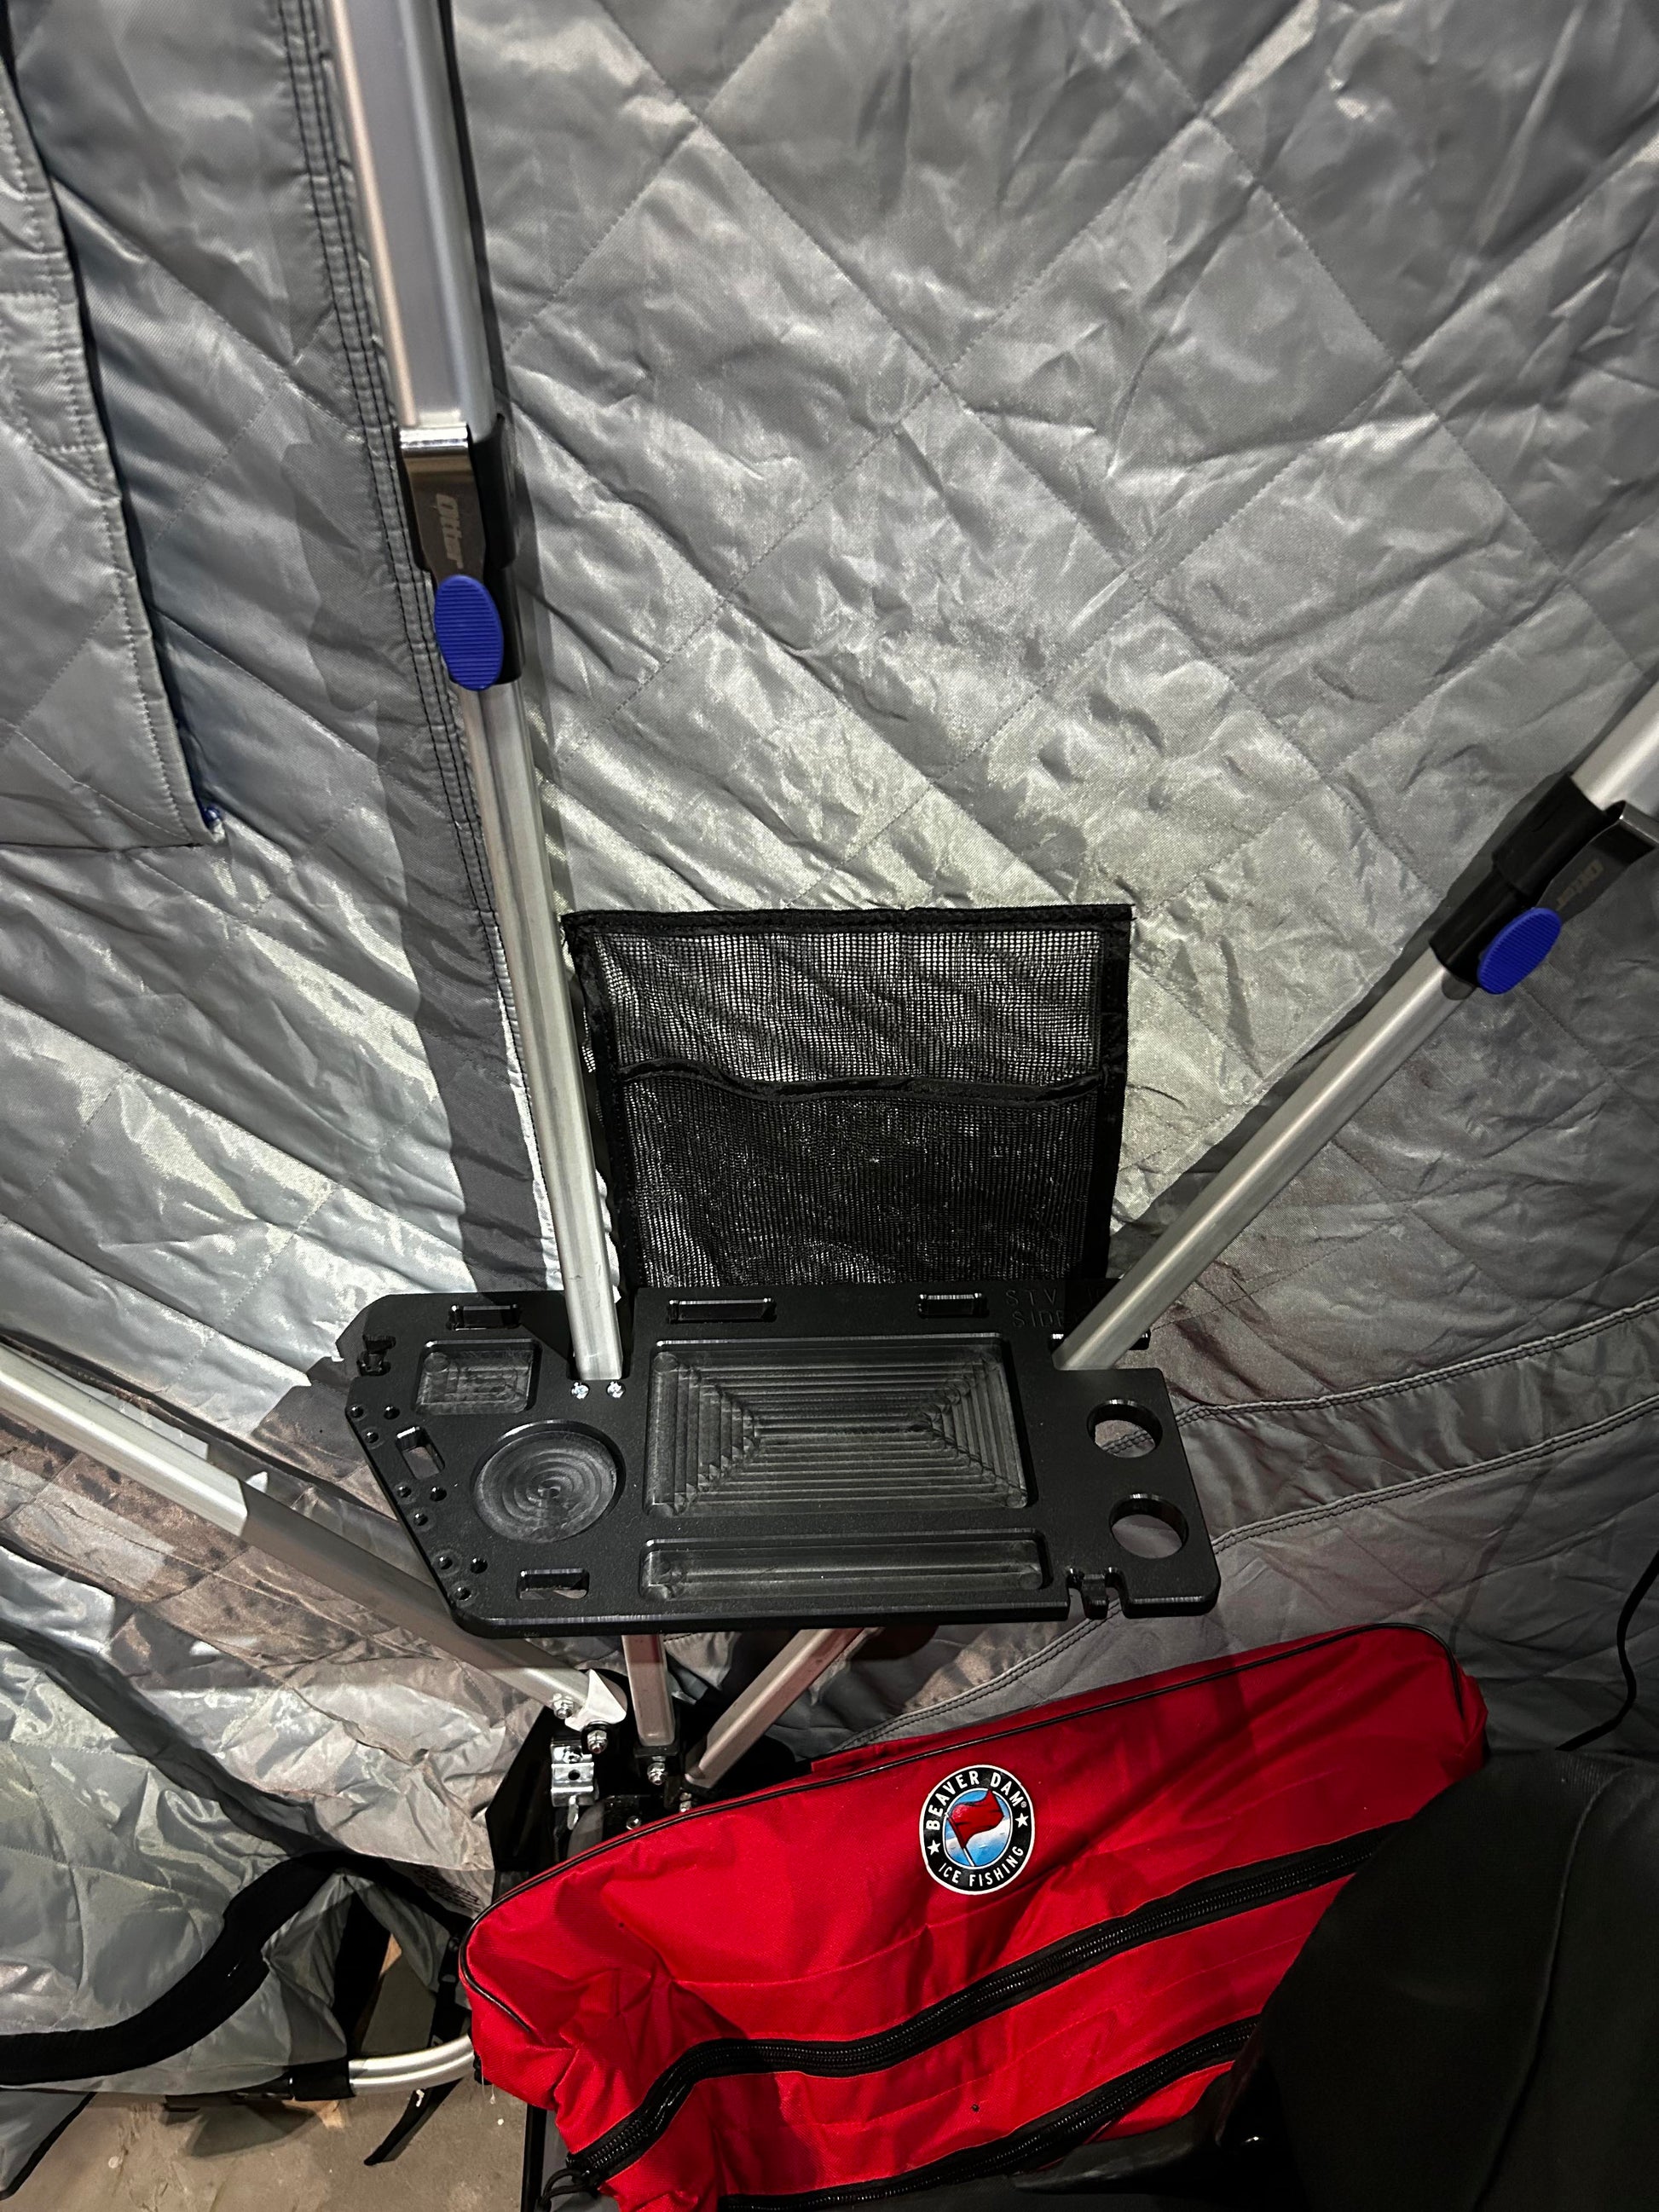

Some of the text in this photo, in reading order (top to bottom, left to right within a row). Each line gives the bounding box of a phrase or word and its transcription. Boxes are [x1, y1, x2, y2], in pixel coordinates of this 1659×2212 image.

[926, 1770, 980, 1831] BEAVER
[938, 1845, 1024, 1887] ICE FISHING
